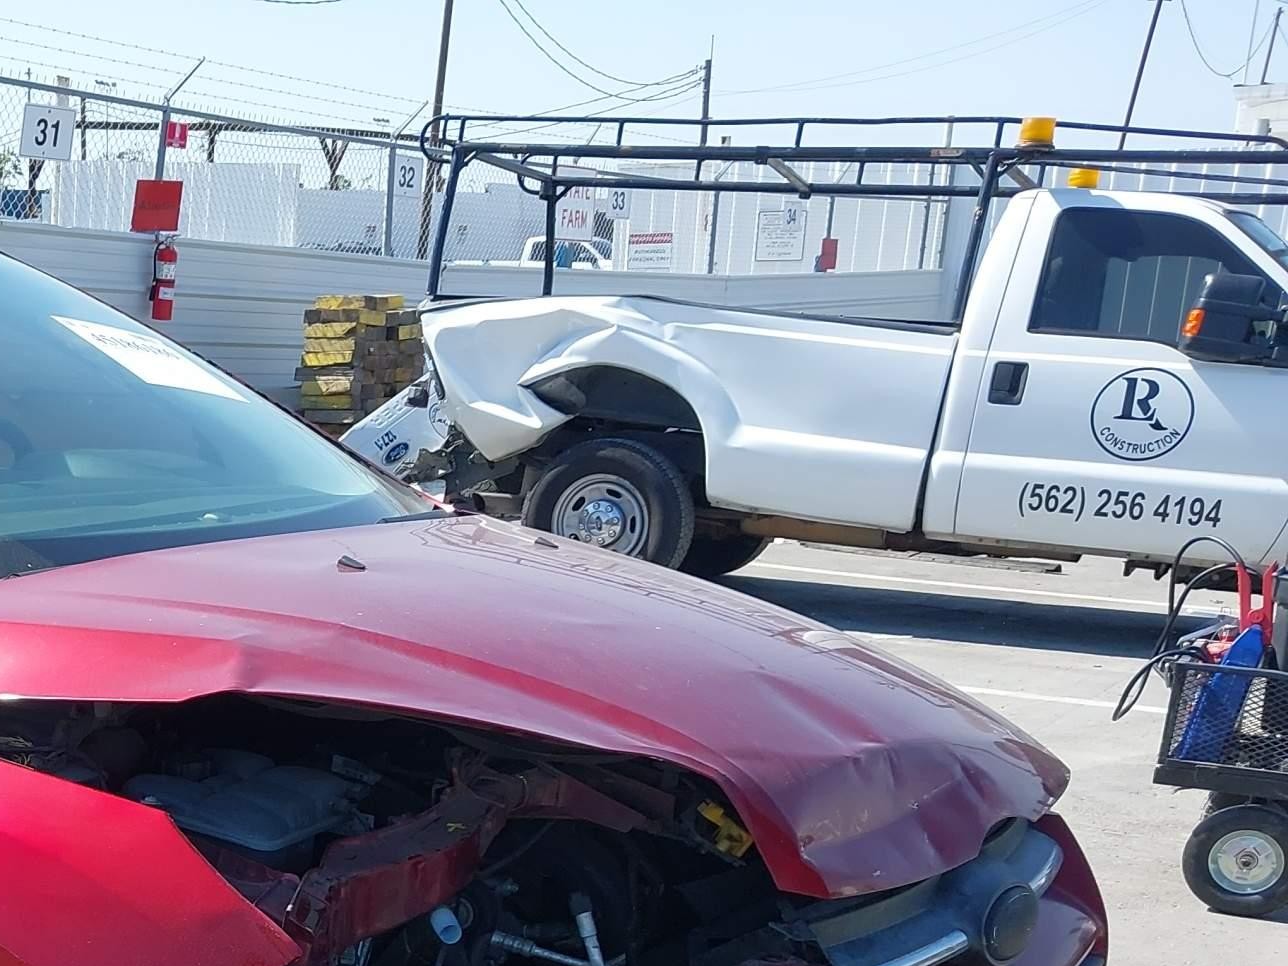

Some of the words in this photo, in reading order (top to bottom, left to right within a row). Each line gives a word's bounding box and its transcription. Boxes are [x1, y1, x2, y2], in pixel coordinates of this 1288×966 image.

[34, 118, 60, 147] 31
[398, 165, 415, 188] 32
[612, 191, 626, 210] 33
[561, 208, 588, 229] FARM
[786, 208, 797, 225] 34
[1099, 426, 1182, 454] CONSTRUCTION
[1018, 482, 1086, 523] (562)
[1093, 488, 1146, 521] 256
[1152, 494, 1223, 528] 4194
